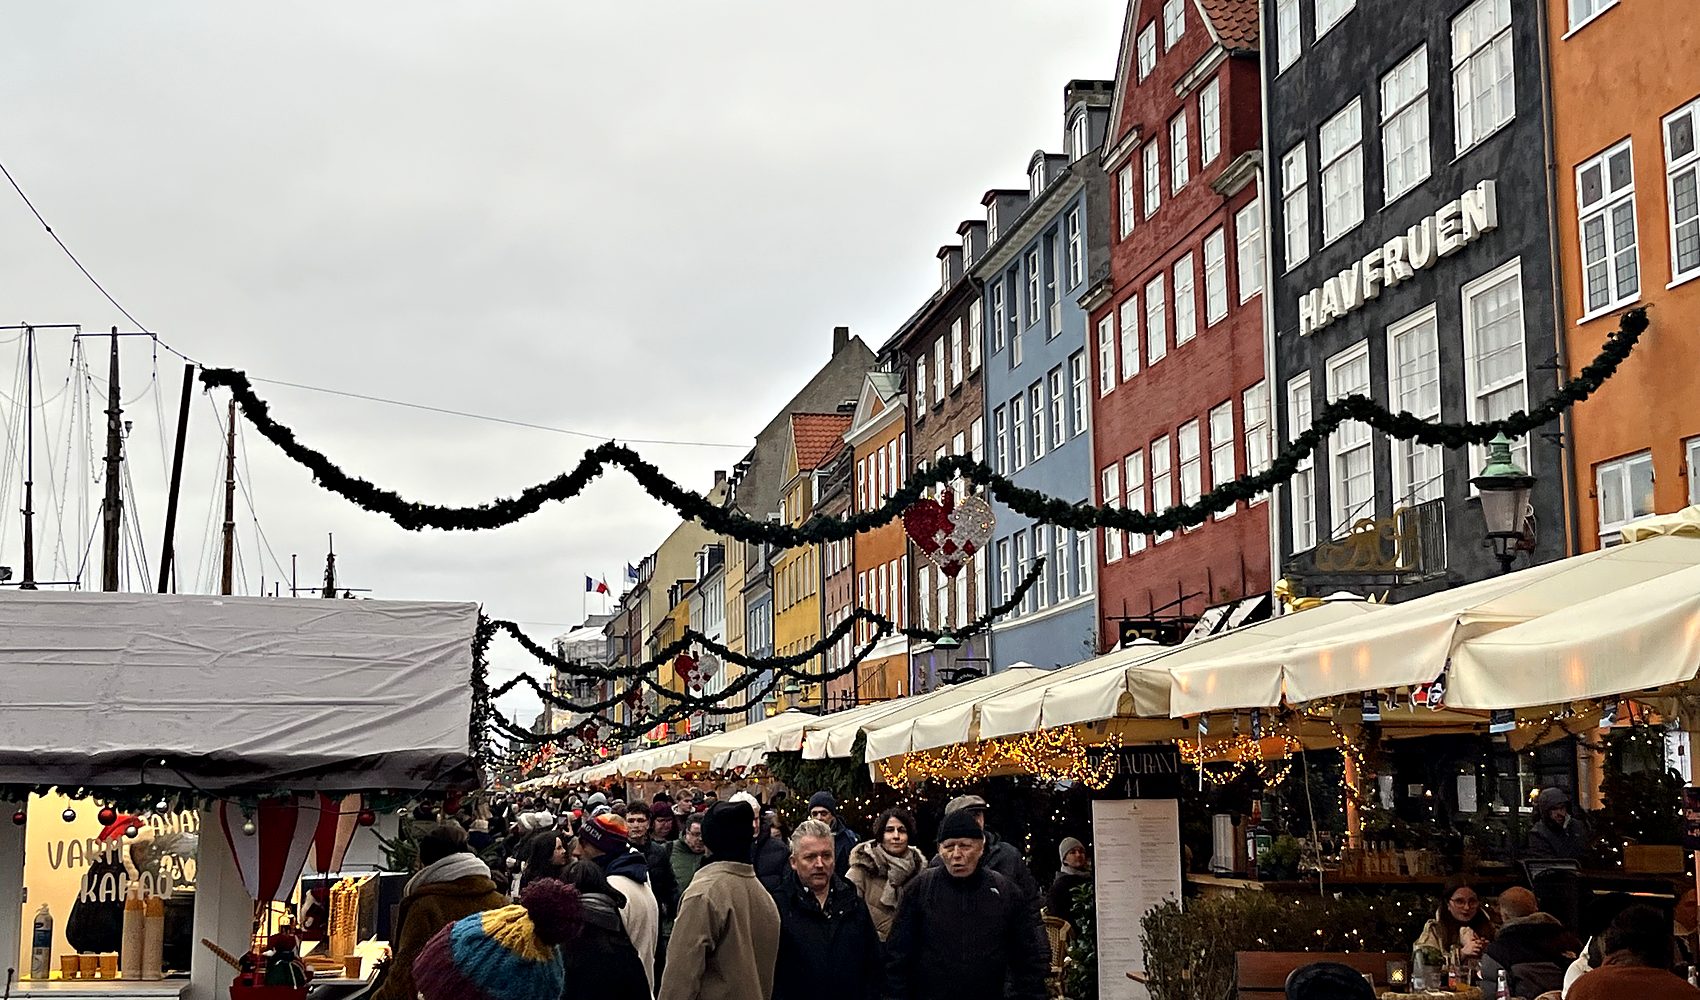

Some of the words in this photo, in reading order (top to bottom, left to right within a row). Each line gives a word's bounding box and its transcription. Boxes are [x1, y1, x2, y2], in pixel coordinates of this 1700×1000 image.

[1299, 179, 1498, 337] HAVFRUEN
[47, 836, 124, 870] VARM
[80, 871, 174, 904] KAKAO
